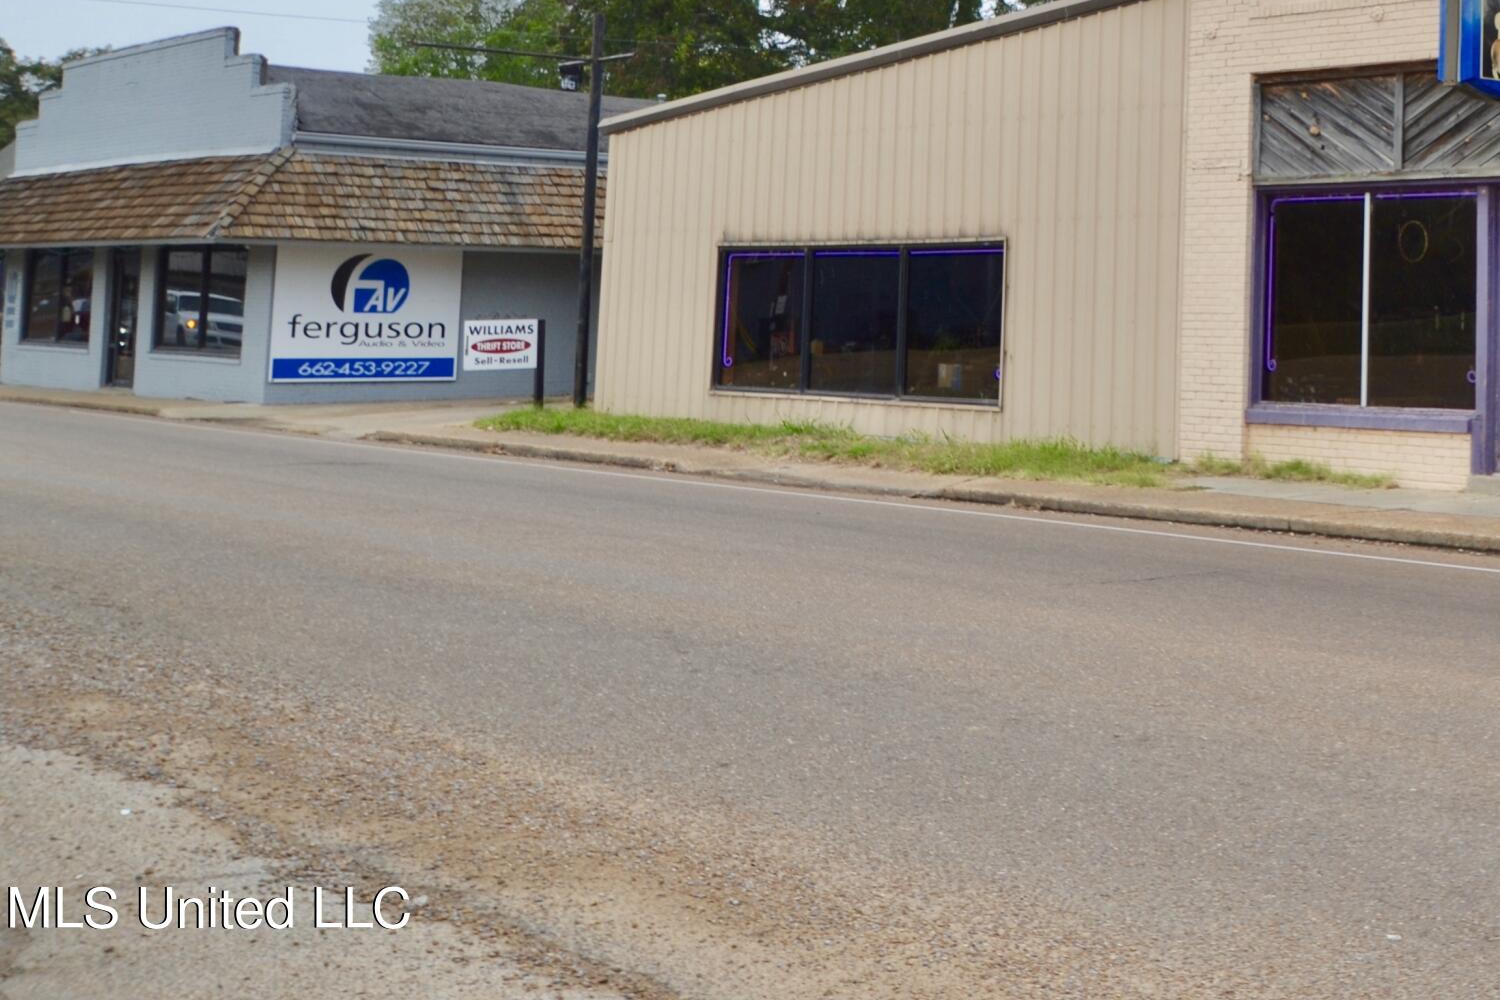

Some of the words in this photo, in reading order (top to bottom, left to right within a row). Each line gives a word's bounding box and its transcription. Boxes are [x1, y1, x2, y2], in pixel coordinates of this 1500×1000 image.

[288, 313, 446, 345] ferguson
[469, 324, 534, 335] WILLIAMS
[358, 339, 393, 348] Audio
[398, 340, 407, 348] &
[413, 339, 446, 348] Video
[476, 342, 501, 351] THRIFT
[502, 341, 526, 350] STORE
[298, 361, 431, 376] 662-453-9227
